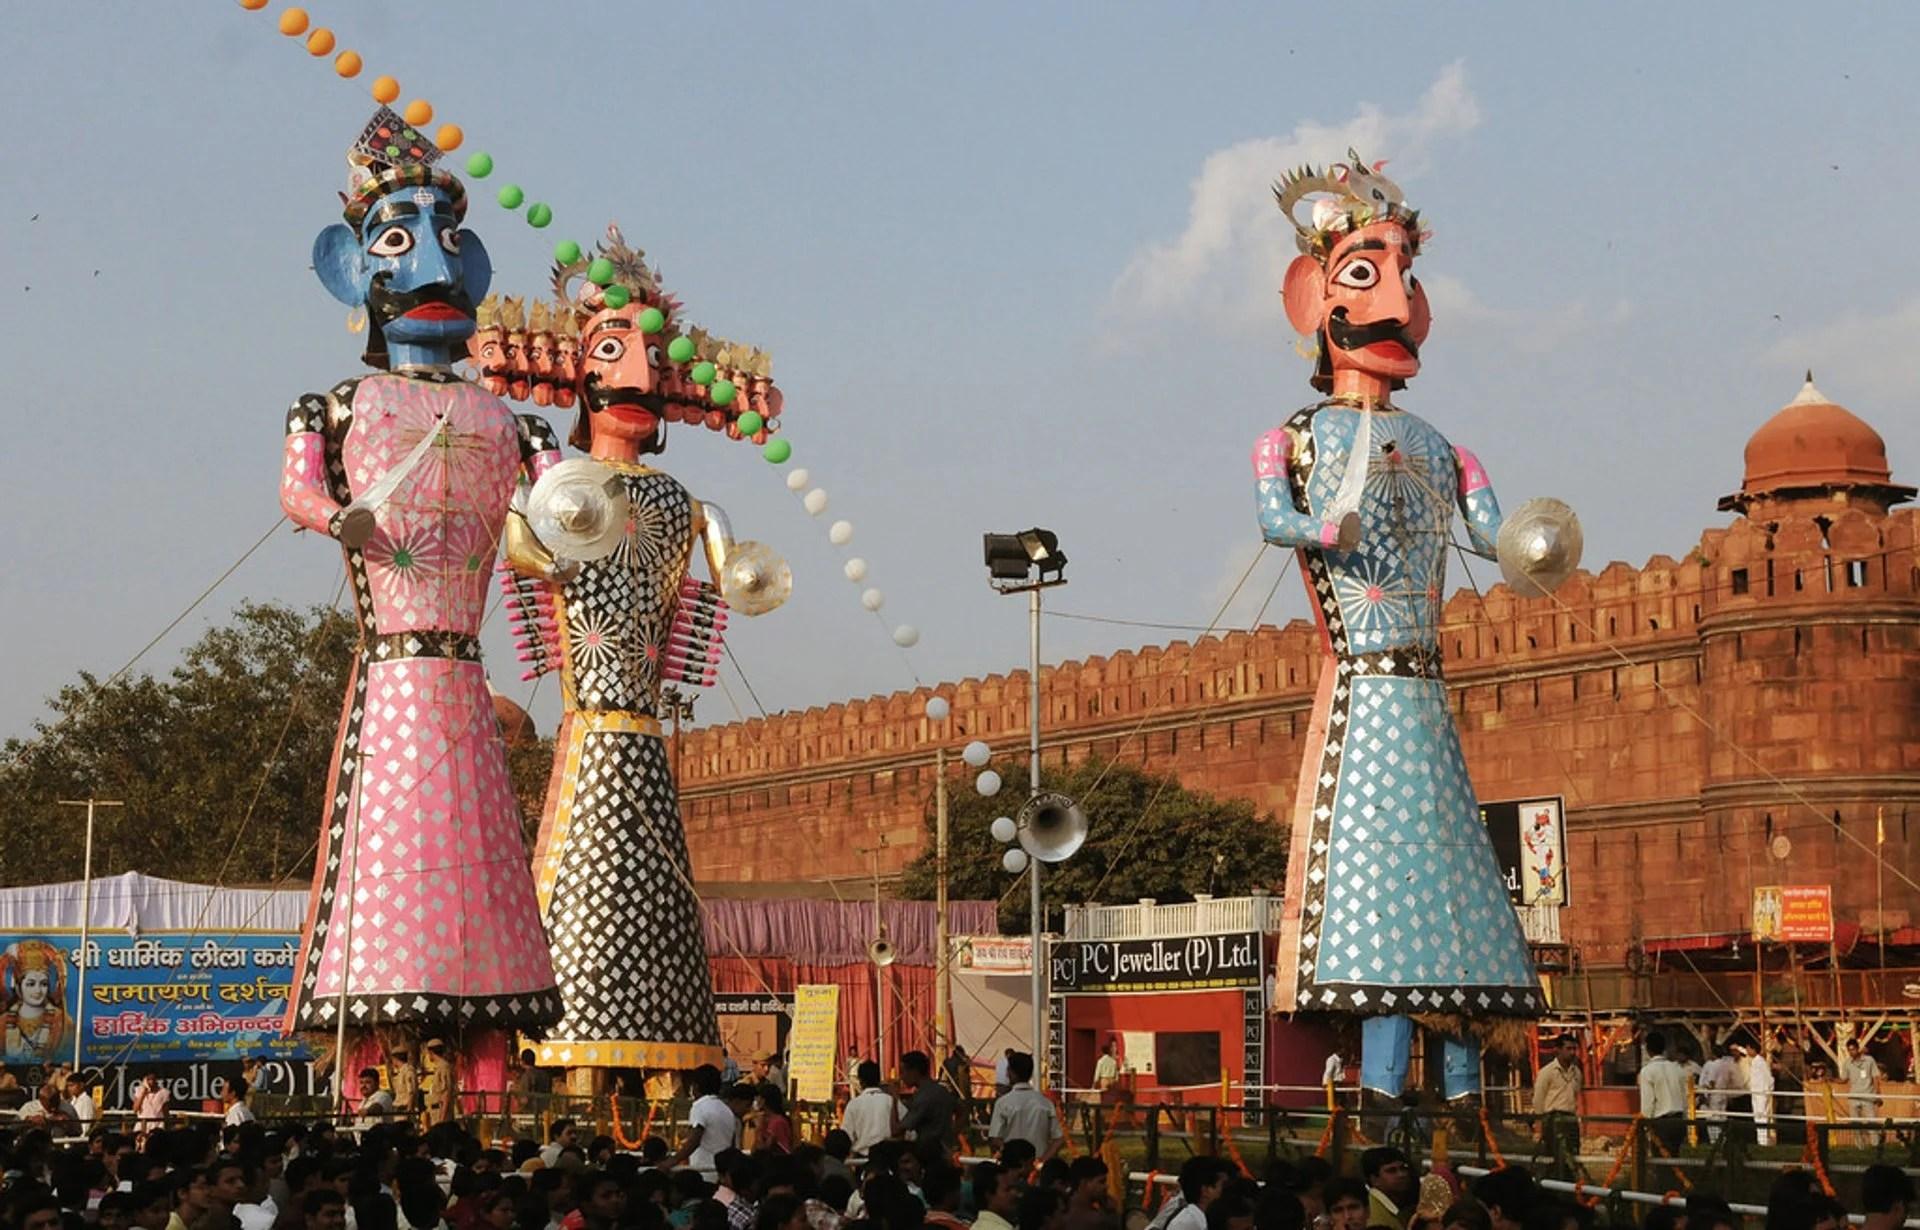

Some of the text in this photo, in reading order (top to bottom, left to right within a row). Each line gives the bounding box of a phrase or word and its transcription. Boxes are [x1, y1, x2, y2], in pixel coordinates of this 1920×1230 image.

[71, 940, 300, 968] श्री धार्मिक लीला कमे
[1082, 943, 1108, 974] PC
[1110, 941, 1182, 980] Jeweller
[1185, 936, 1213, 977] (P)
[1217, 935, 1258, 969] Ltd.
[1053, 957, 1076, 986] PCJ
[93, 976, 291, 1003] रामायण दर्शन
[93, 1011, 168, 1038] हार्दिक
